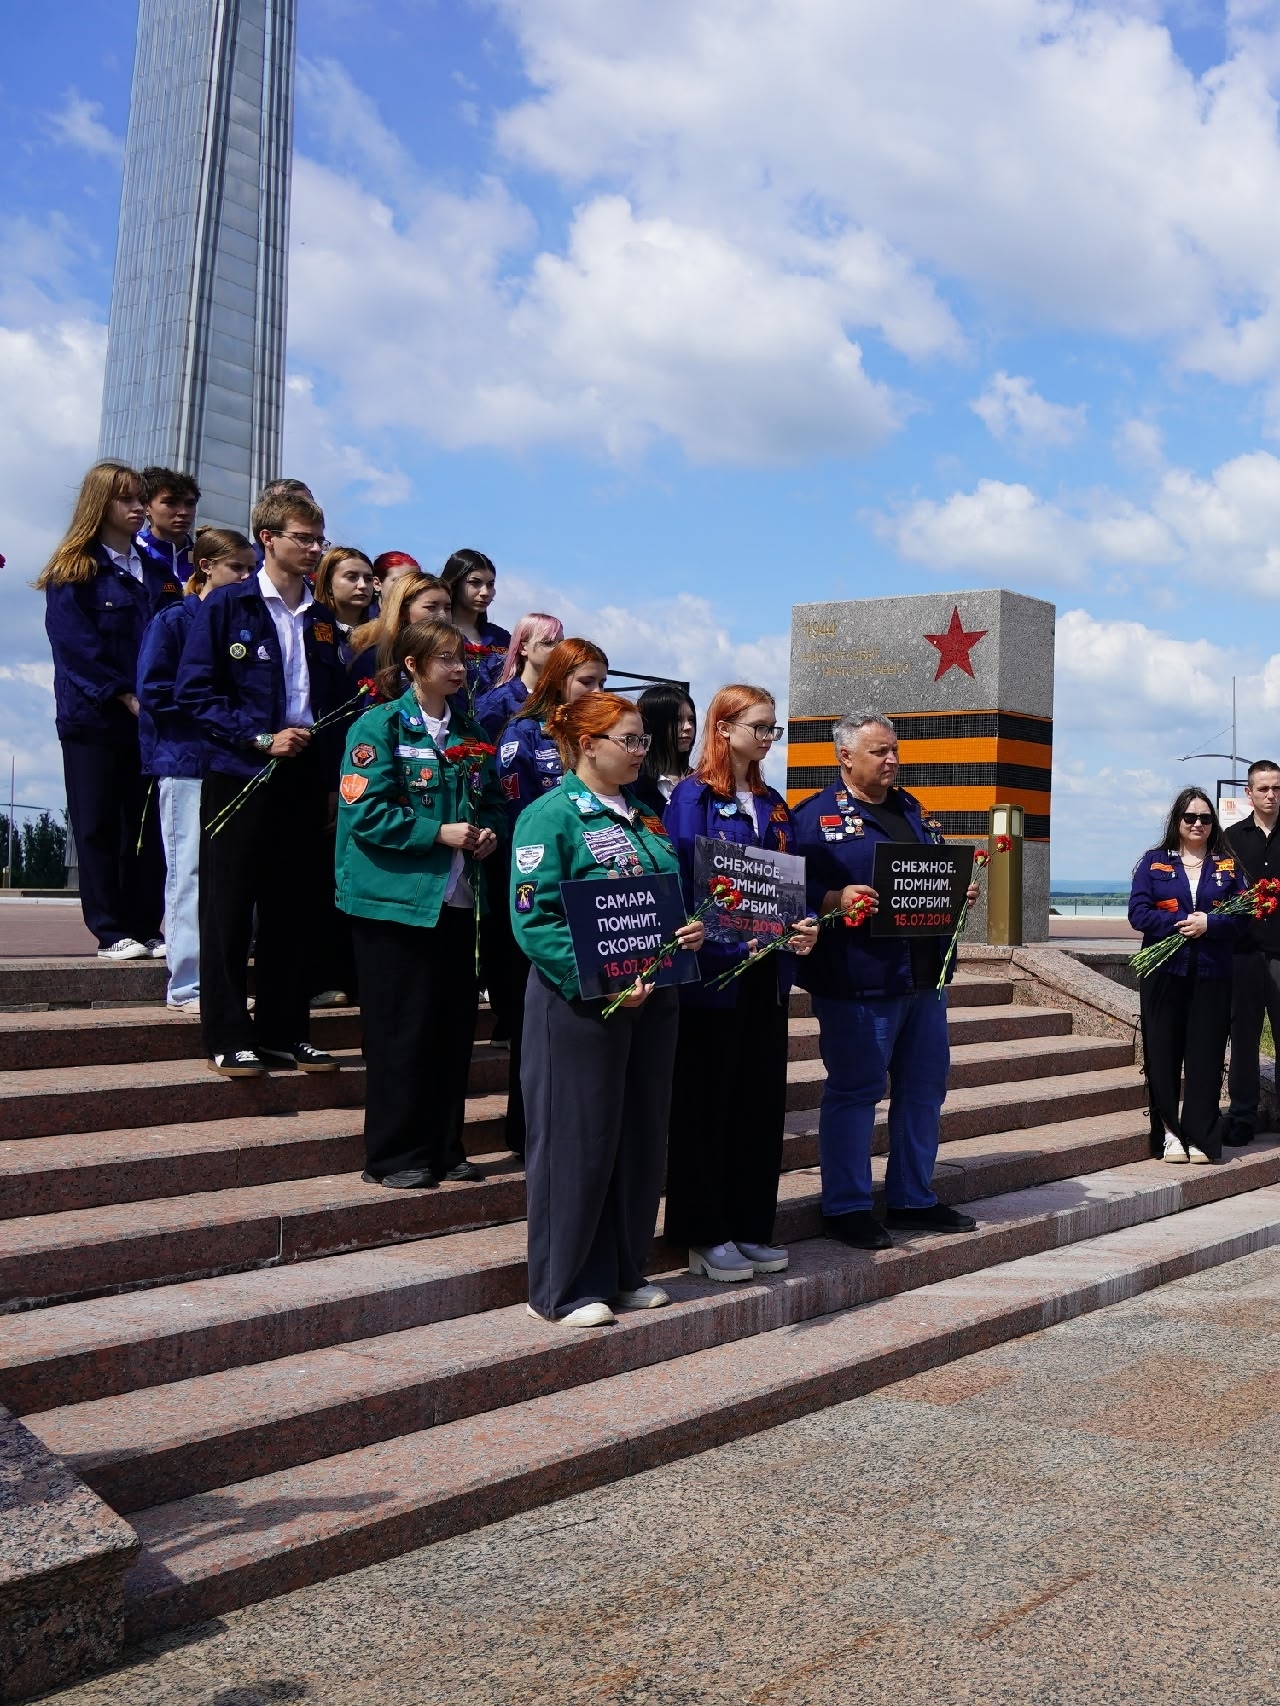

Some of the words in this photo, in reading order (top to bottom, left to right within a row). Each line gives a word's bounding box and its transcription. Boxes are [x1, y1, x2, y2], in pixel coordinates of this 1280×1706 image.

[803, 620, 837, 639] 1944
[714, 855, 784, 880] СНЕЖНОЕ.
[891, 860, 957, 874] СНЕЖНОЕ.
[894, 878, 952, 891] ПОМНИМ.
[595, 890, 656, 910] САМАРА
[714, 896, 783, 916] СРБИМ.
[891, 896, 952, 909] СКОРБИМ.
[597, 912, 661, 933] ПОМНИТ.
[893, 913, 951, 927] 15.07.2014
[597, 933, 662, 956] СКОРБИТ
